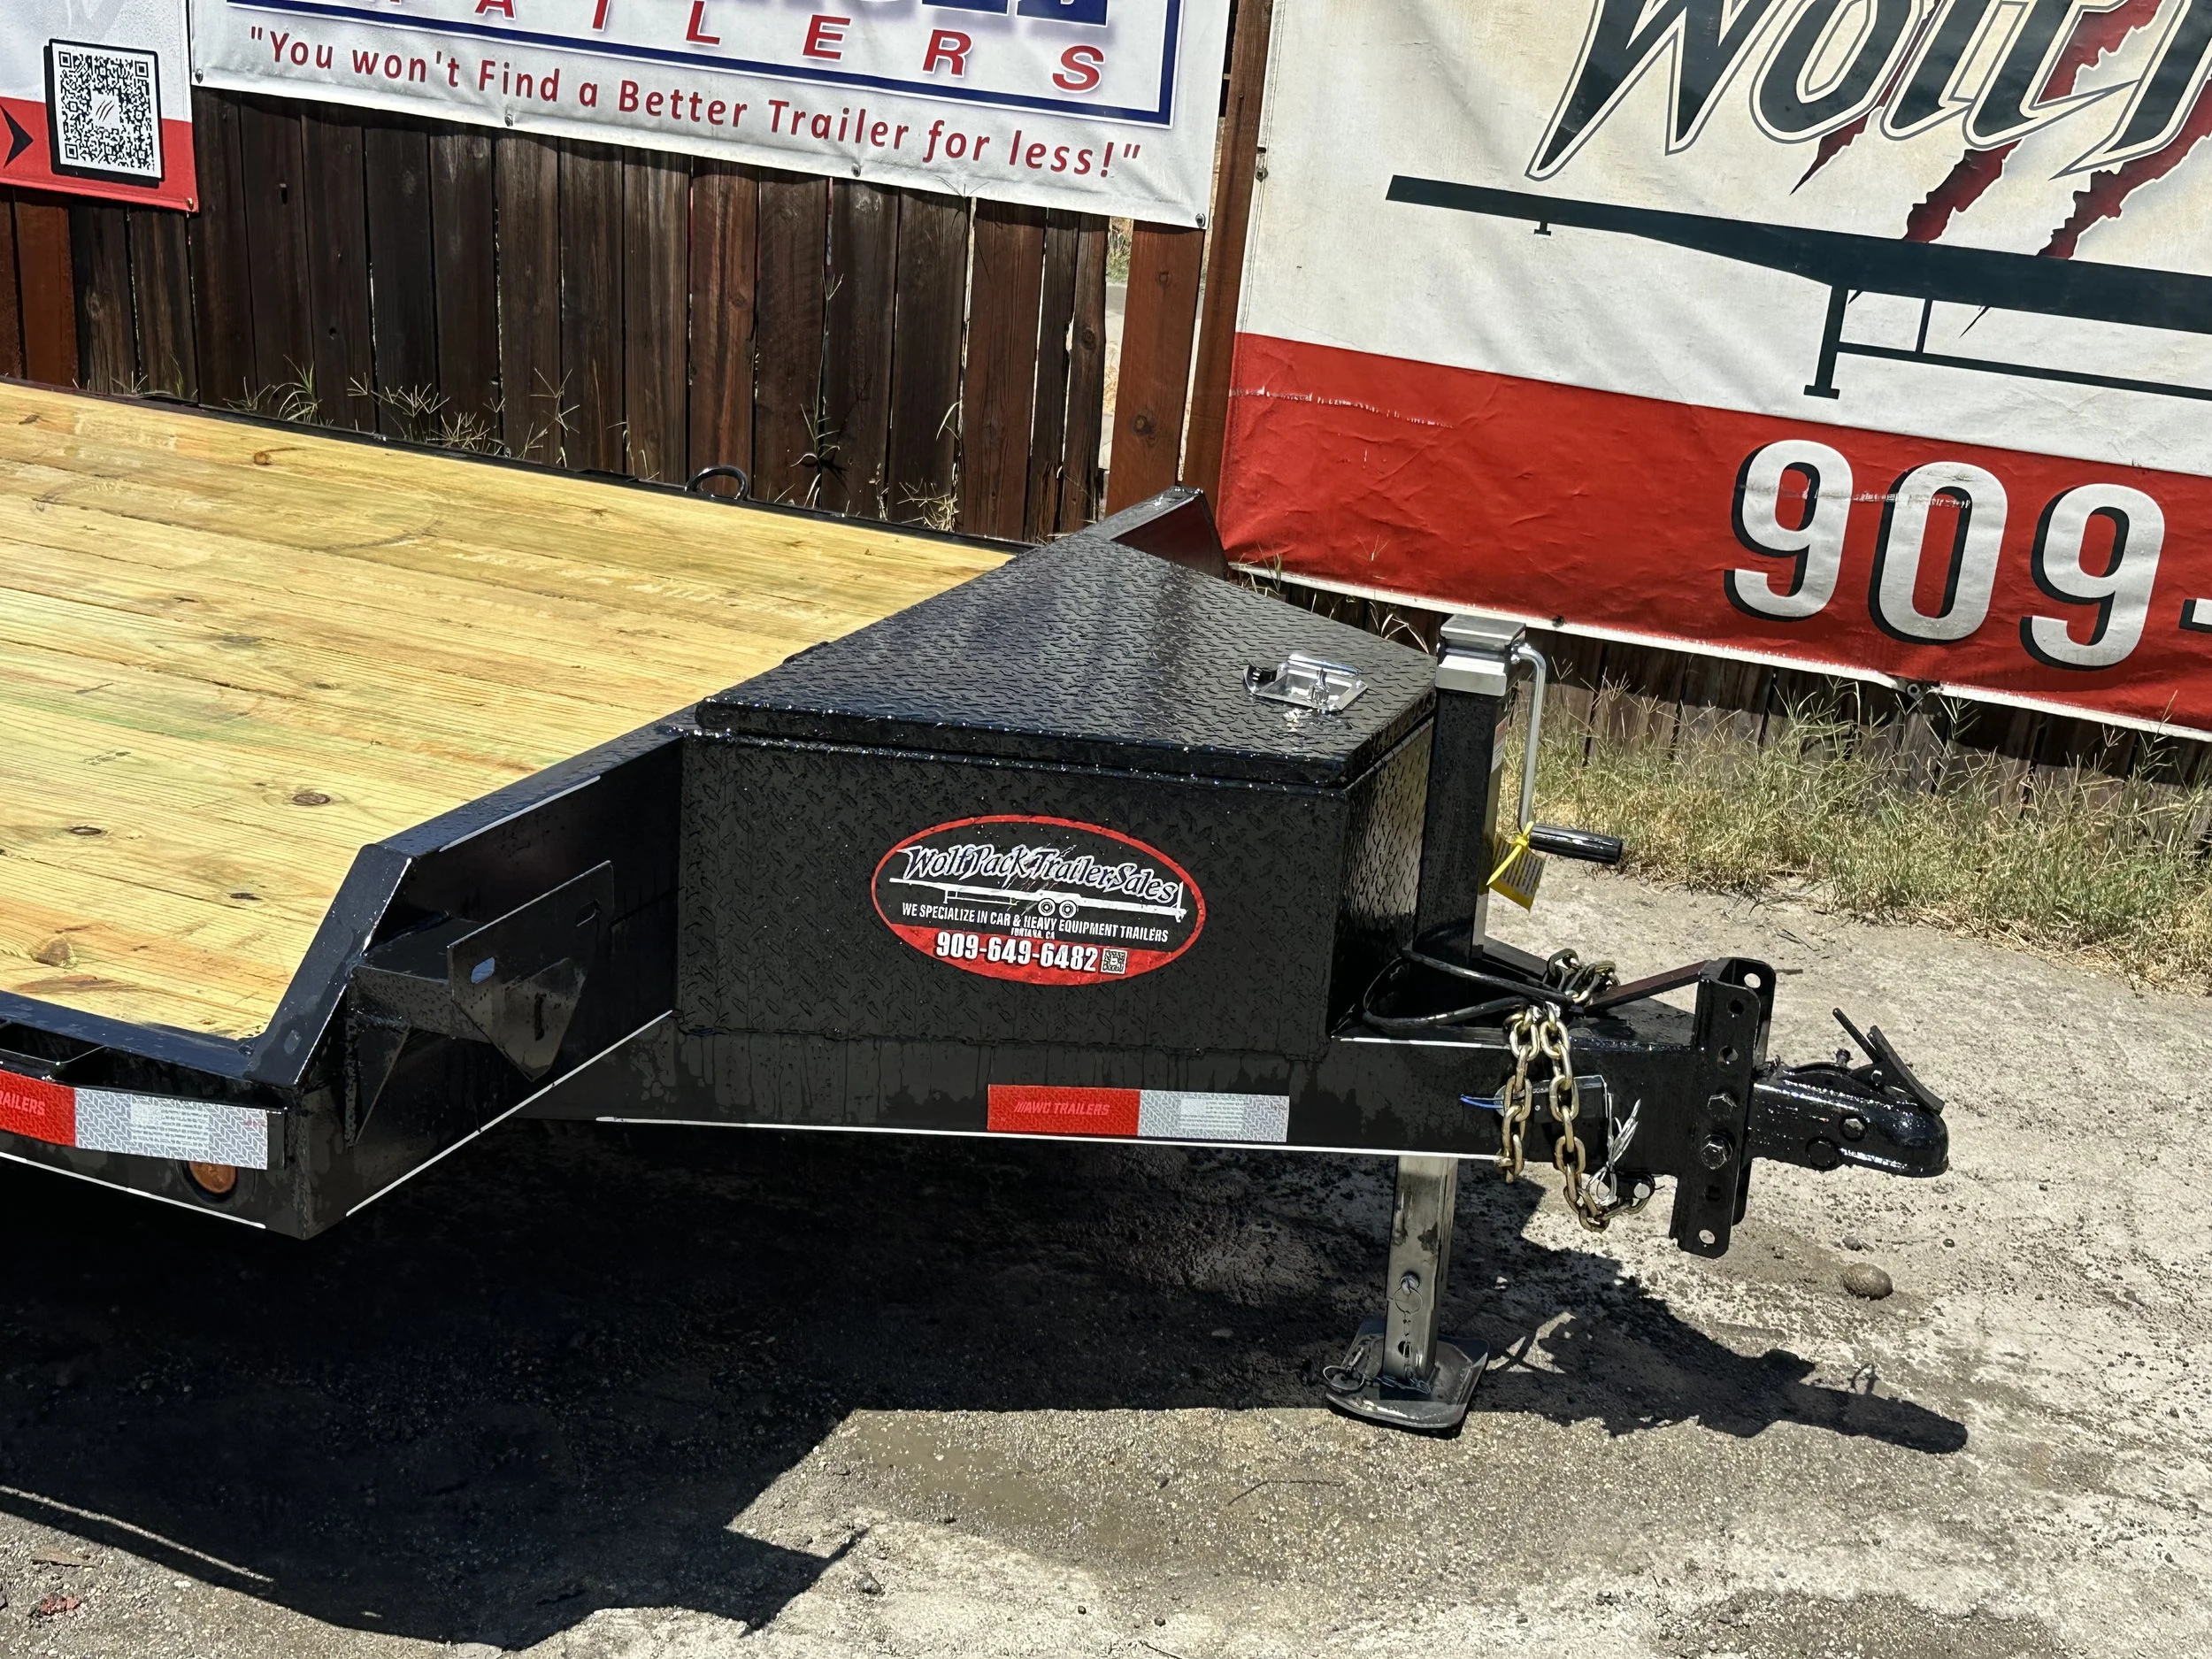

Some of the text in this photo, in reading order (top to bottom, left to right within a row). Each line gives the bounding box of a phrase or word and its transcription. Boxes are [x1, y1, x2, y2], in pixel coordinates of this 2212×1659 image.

[250, 27, 1141, 178] "You won't Find a Better Trailer for less!"
[902, 902, 1169, 943] WE SPECIALIZE IN CAR & HEAVY EQUIPMENT TRAILERS
[936, 931, 1099, 972] 909-649-6482
[1053, 1102, 1110, 1116] TRAILERS
